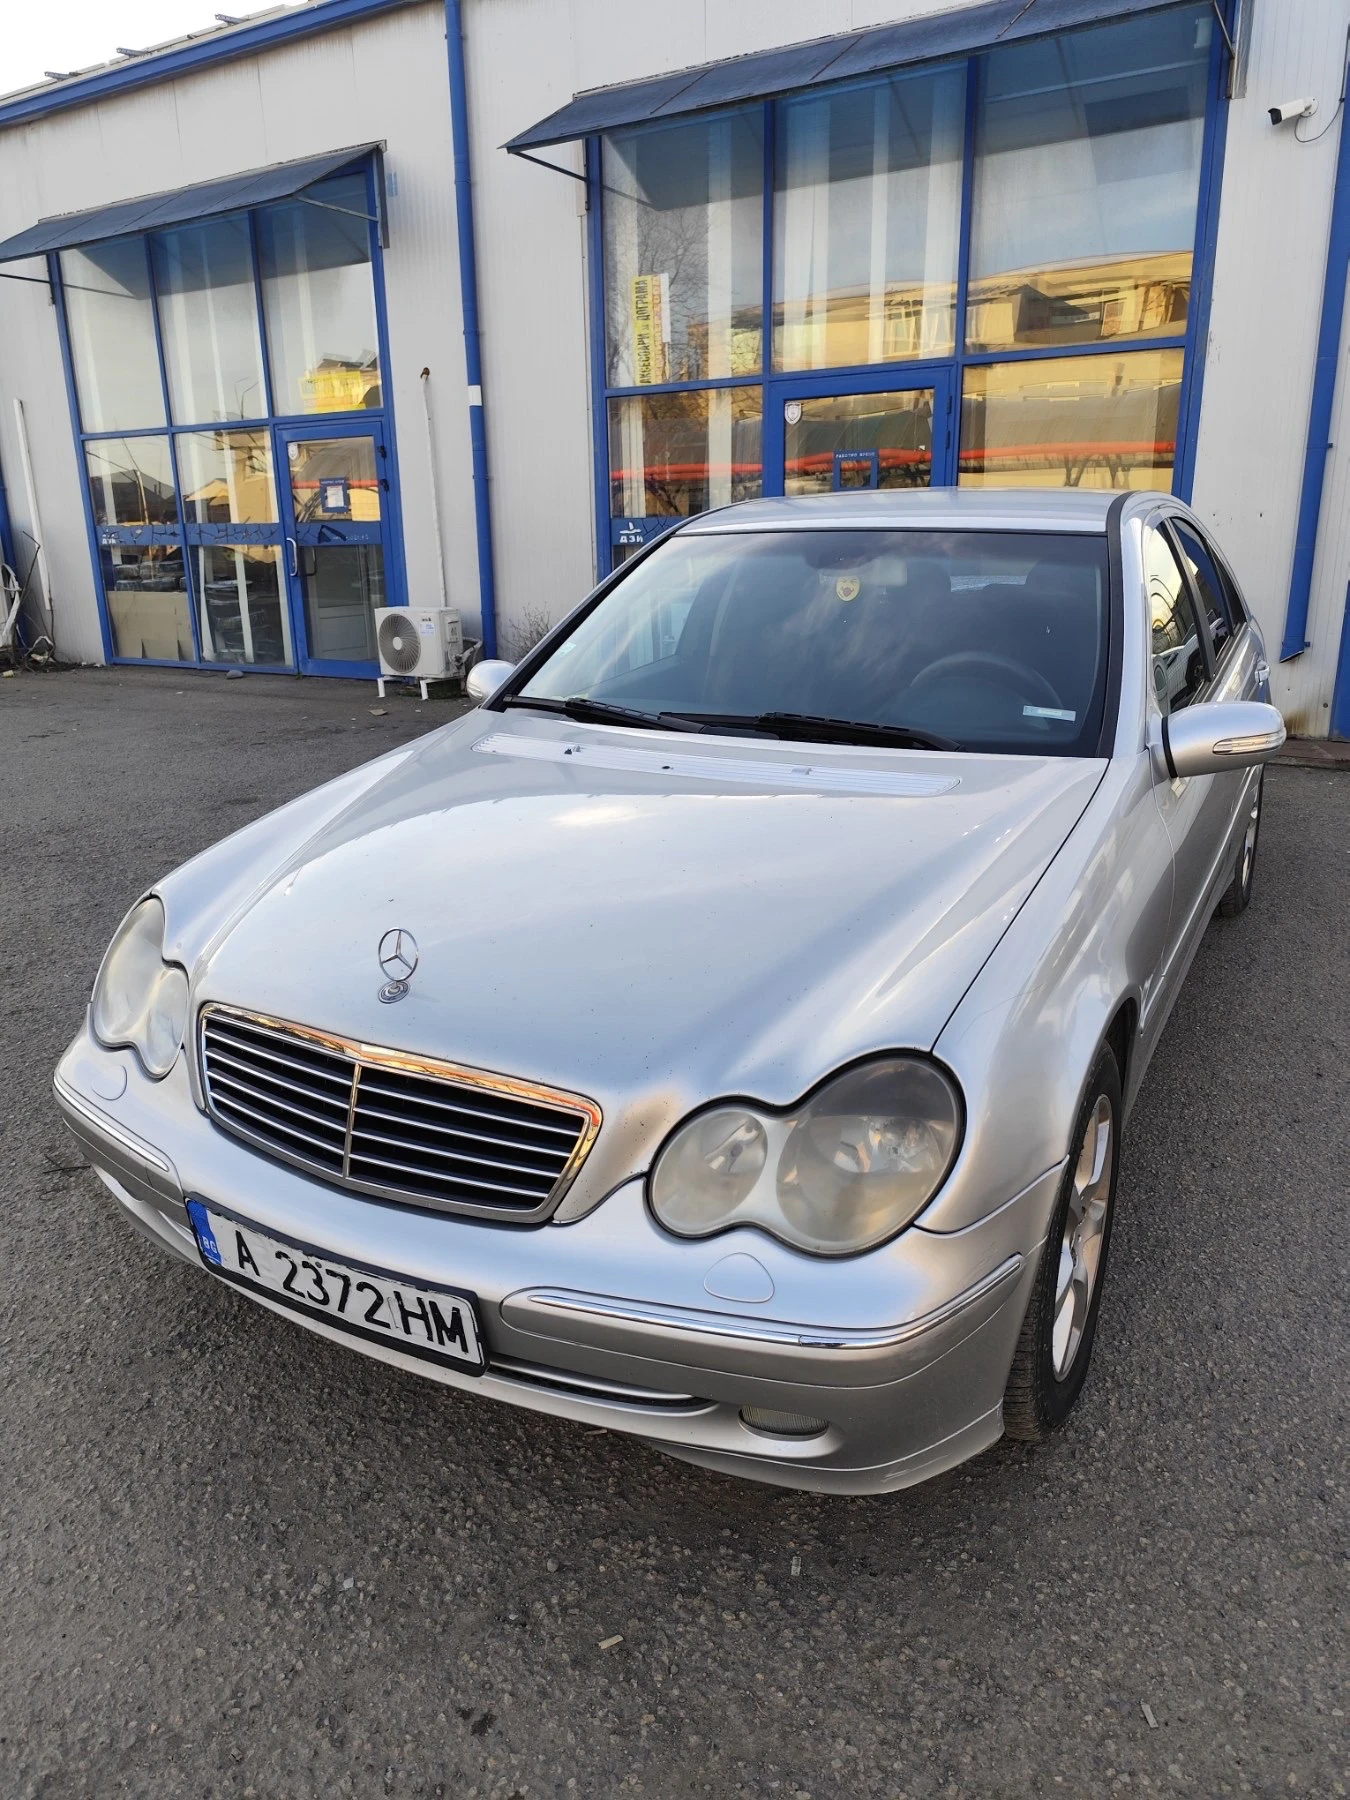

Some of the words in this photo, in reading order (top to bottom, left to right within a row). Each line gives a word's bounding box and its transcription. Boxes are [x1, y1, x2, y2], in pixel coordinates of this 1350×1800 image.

[635, 279, 651, 321] ДОГРАМА
[637, 334, 652, 384] АКСЕСОАРИ
[620, 535, 643, 543] ДЗИ
[202, 1235, 218, 1254] BG
[235, 1230, 261, 1277] A
[275, 1250, 392, 1330] 2372
[393, 1290, 469, 1355] HM
